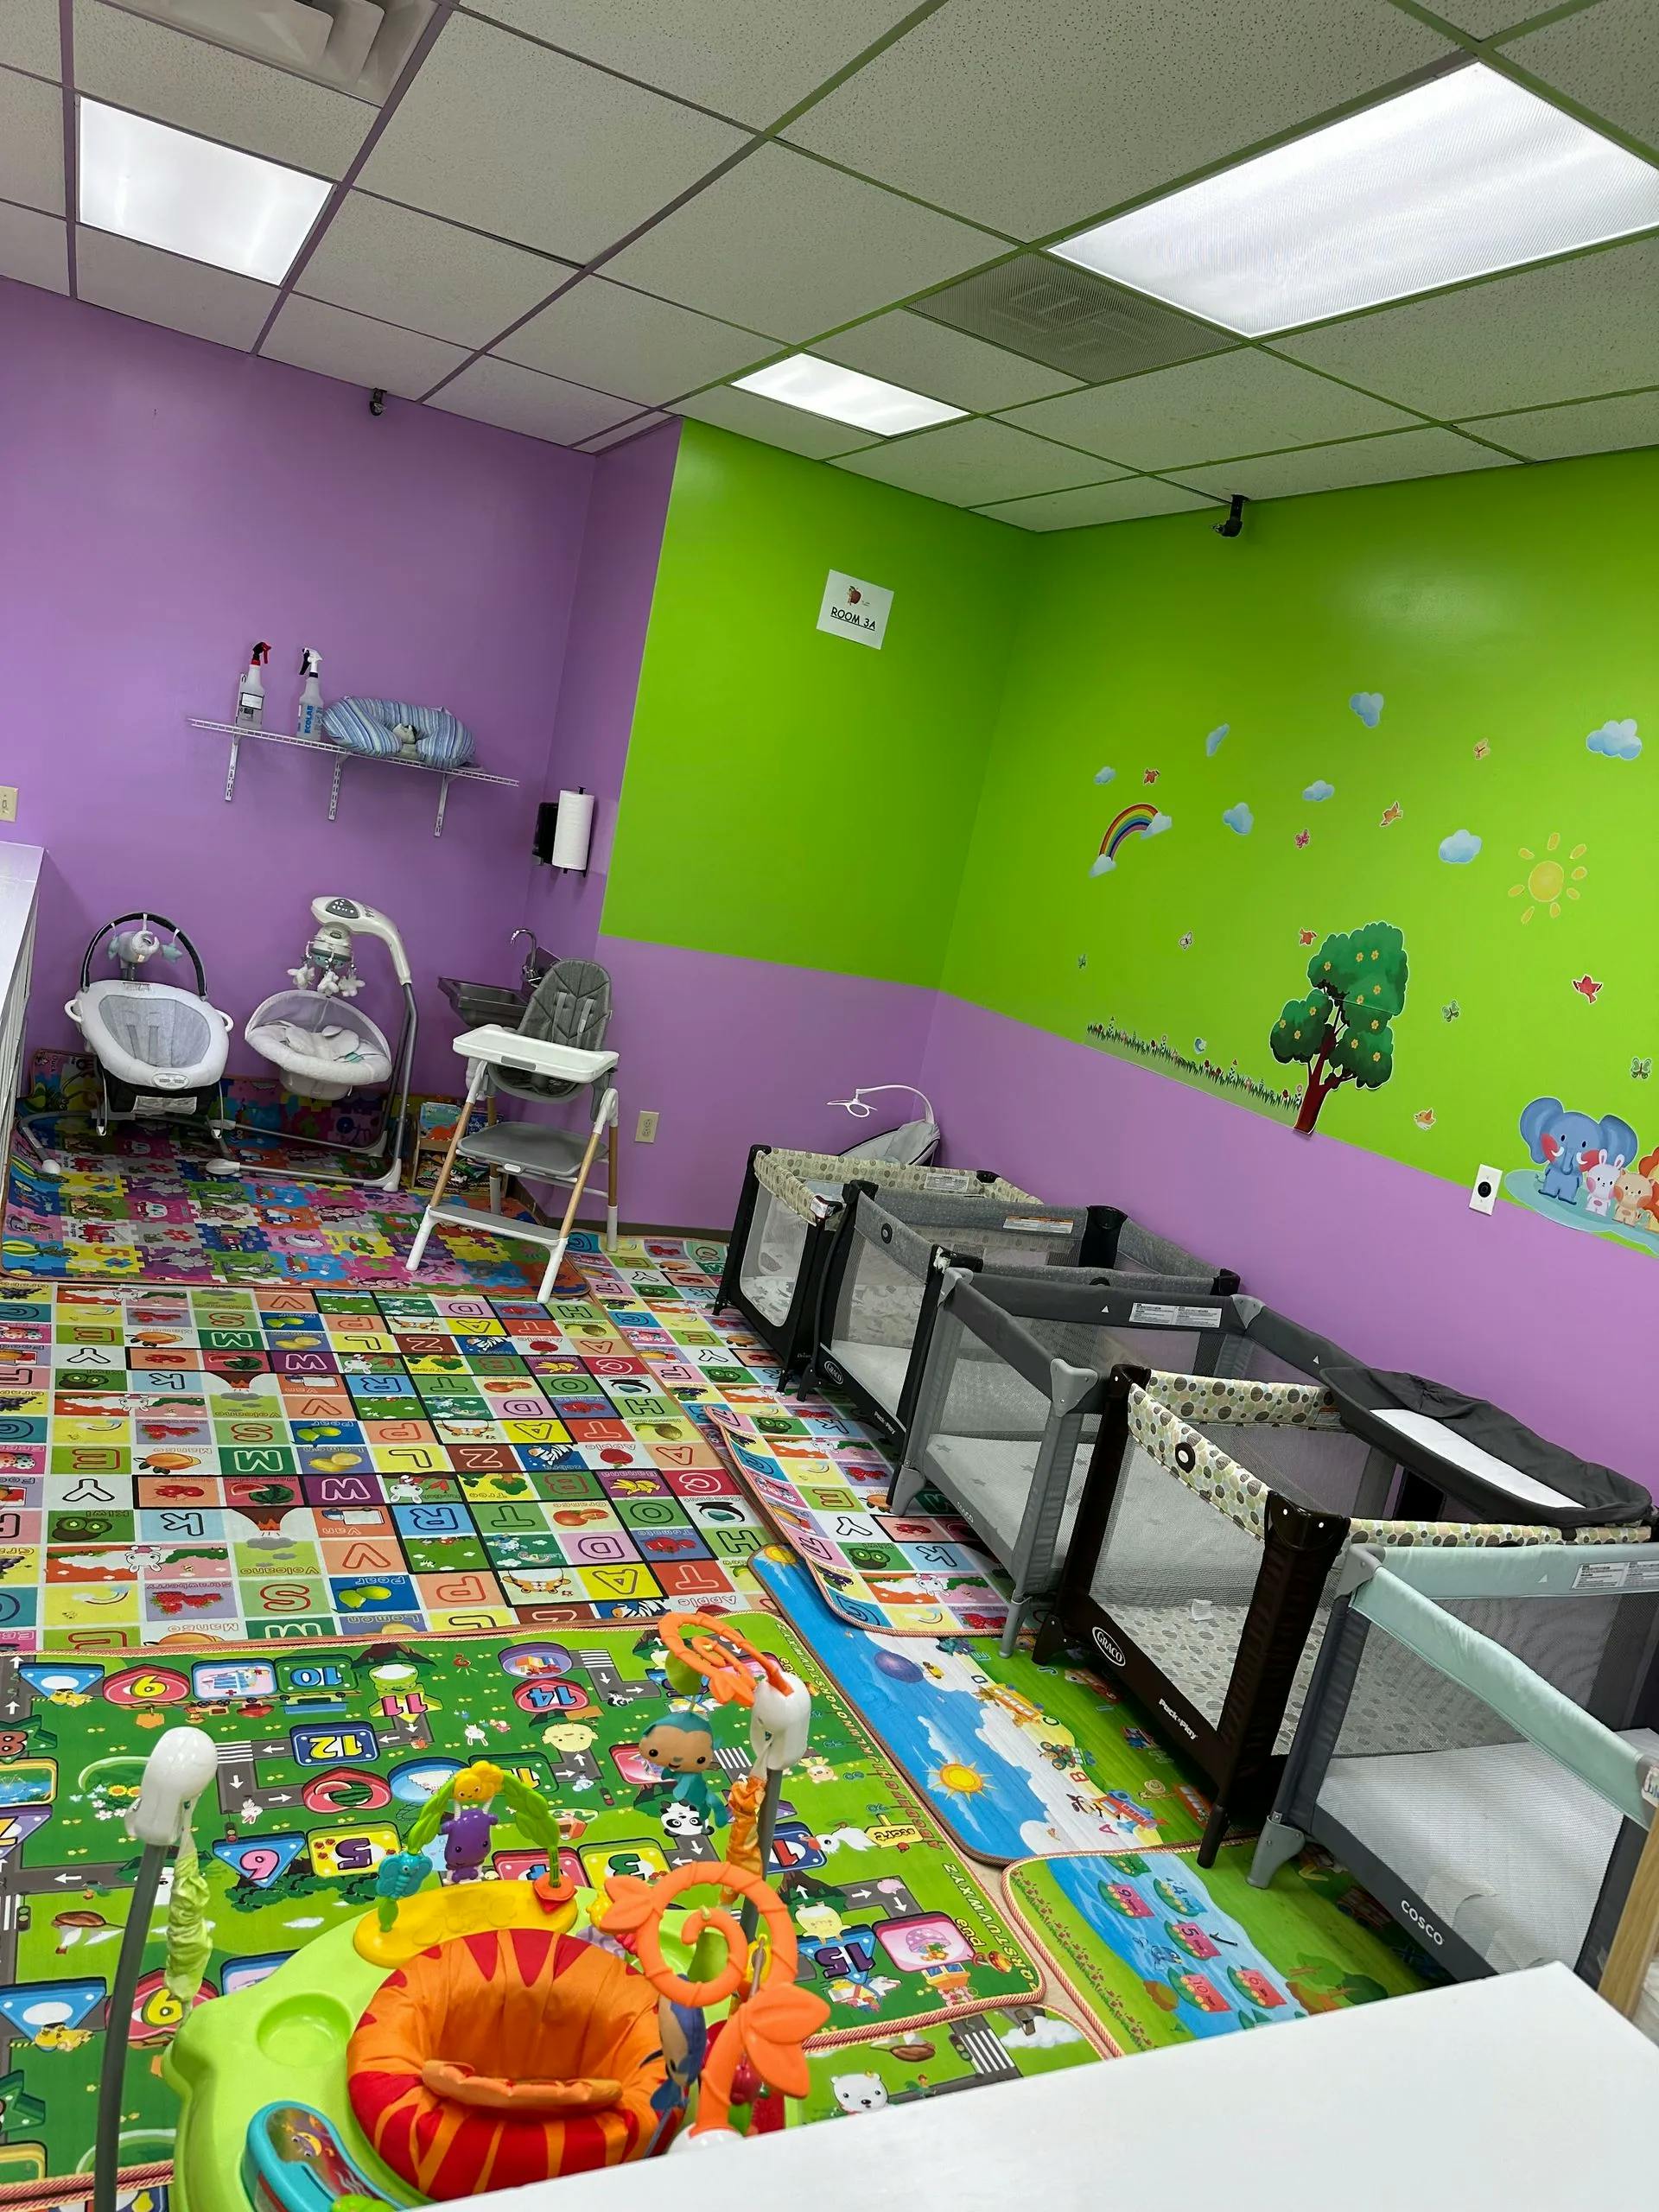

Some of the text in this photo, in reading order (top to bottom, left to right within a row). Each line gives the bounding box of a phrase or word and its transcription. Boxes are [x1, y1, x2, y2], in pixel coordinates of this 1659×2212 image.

[830, 607, 876, 630] ROOM 3A
[304, 705, 314, 734] ECOLAB
[240, 1567, 319, 1575] Volcano
[355, 1576, 405, 1585] Pear
[677, 1596, 736, 1606] Apple
[1096, 1630, 1123, 1663] GRACO
[290, 1666, 343, 1688] 10
[381, 1694, 428, 1717] 11
[526, 1685, 577, 1707] 14
[308, 1734, 363, 1759] 12
[874, 1828, 915, 1841] start
[335, 1838, 372, 1870] 5
[955, 1918, 985, 1947] end
[1181, 1928, 1199, 1936] 5
[1401, 1900, 1443, 1945] COSCO
[814, 1943, 875, 1979] 15
